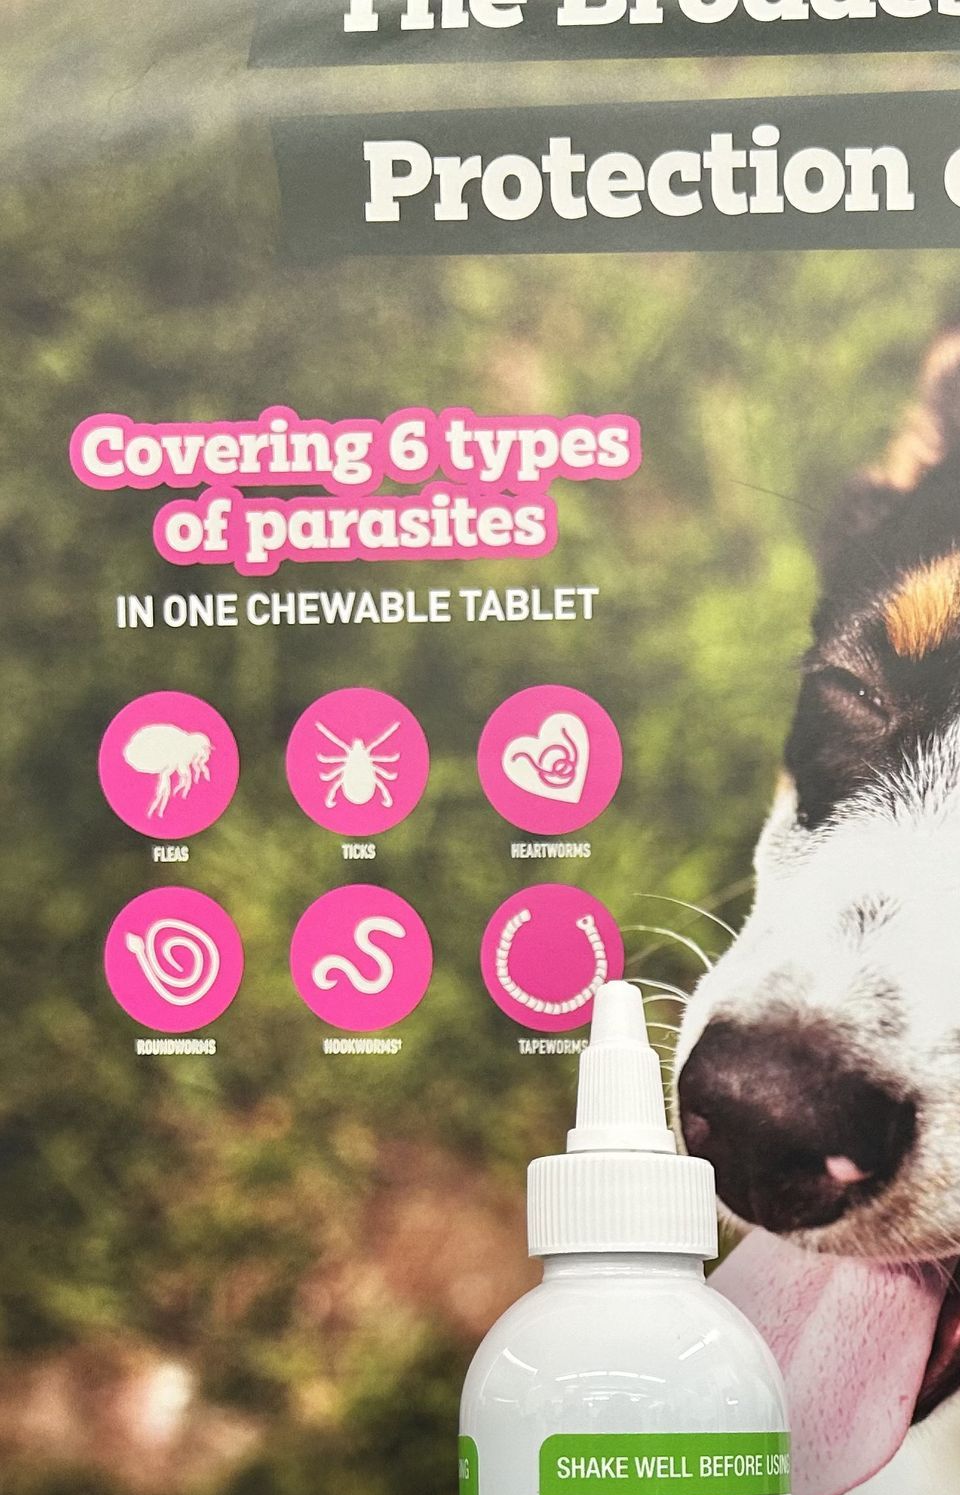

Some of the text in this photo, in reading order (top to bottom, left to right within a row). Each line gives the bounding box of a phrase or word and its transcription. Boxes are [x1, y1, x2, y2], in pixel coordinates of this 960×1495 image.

[364, 124, 915, 223] Protection
[82, 418, 631, 483] Covering 6 types
[165, 493, 546, 562] of parasites
[116, 586, 598, 628] IN ONE CHEWABLE TABLET
[153, 845, 190, 863] FLEAS
[341, 844, 376, 861] TICKS
[511, 843, 591, 859] HEARTWORMS
[136, 1039, 217, 1055] ROUNDWORMS
[557, 1457, 629, 1479] SHAKE
[635, 1457, 693, 1478] WELL
[700, 1455, 763, 1477] BEFORE
